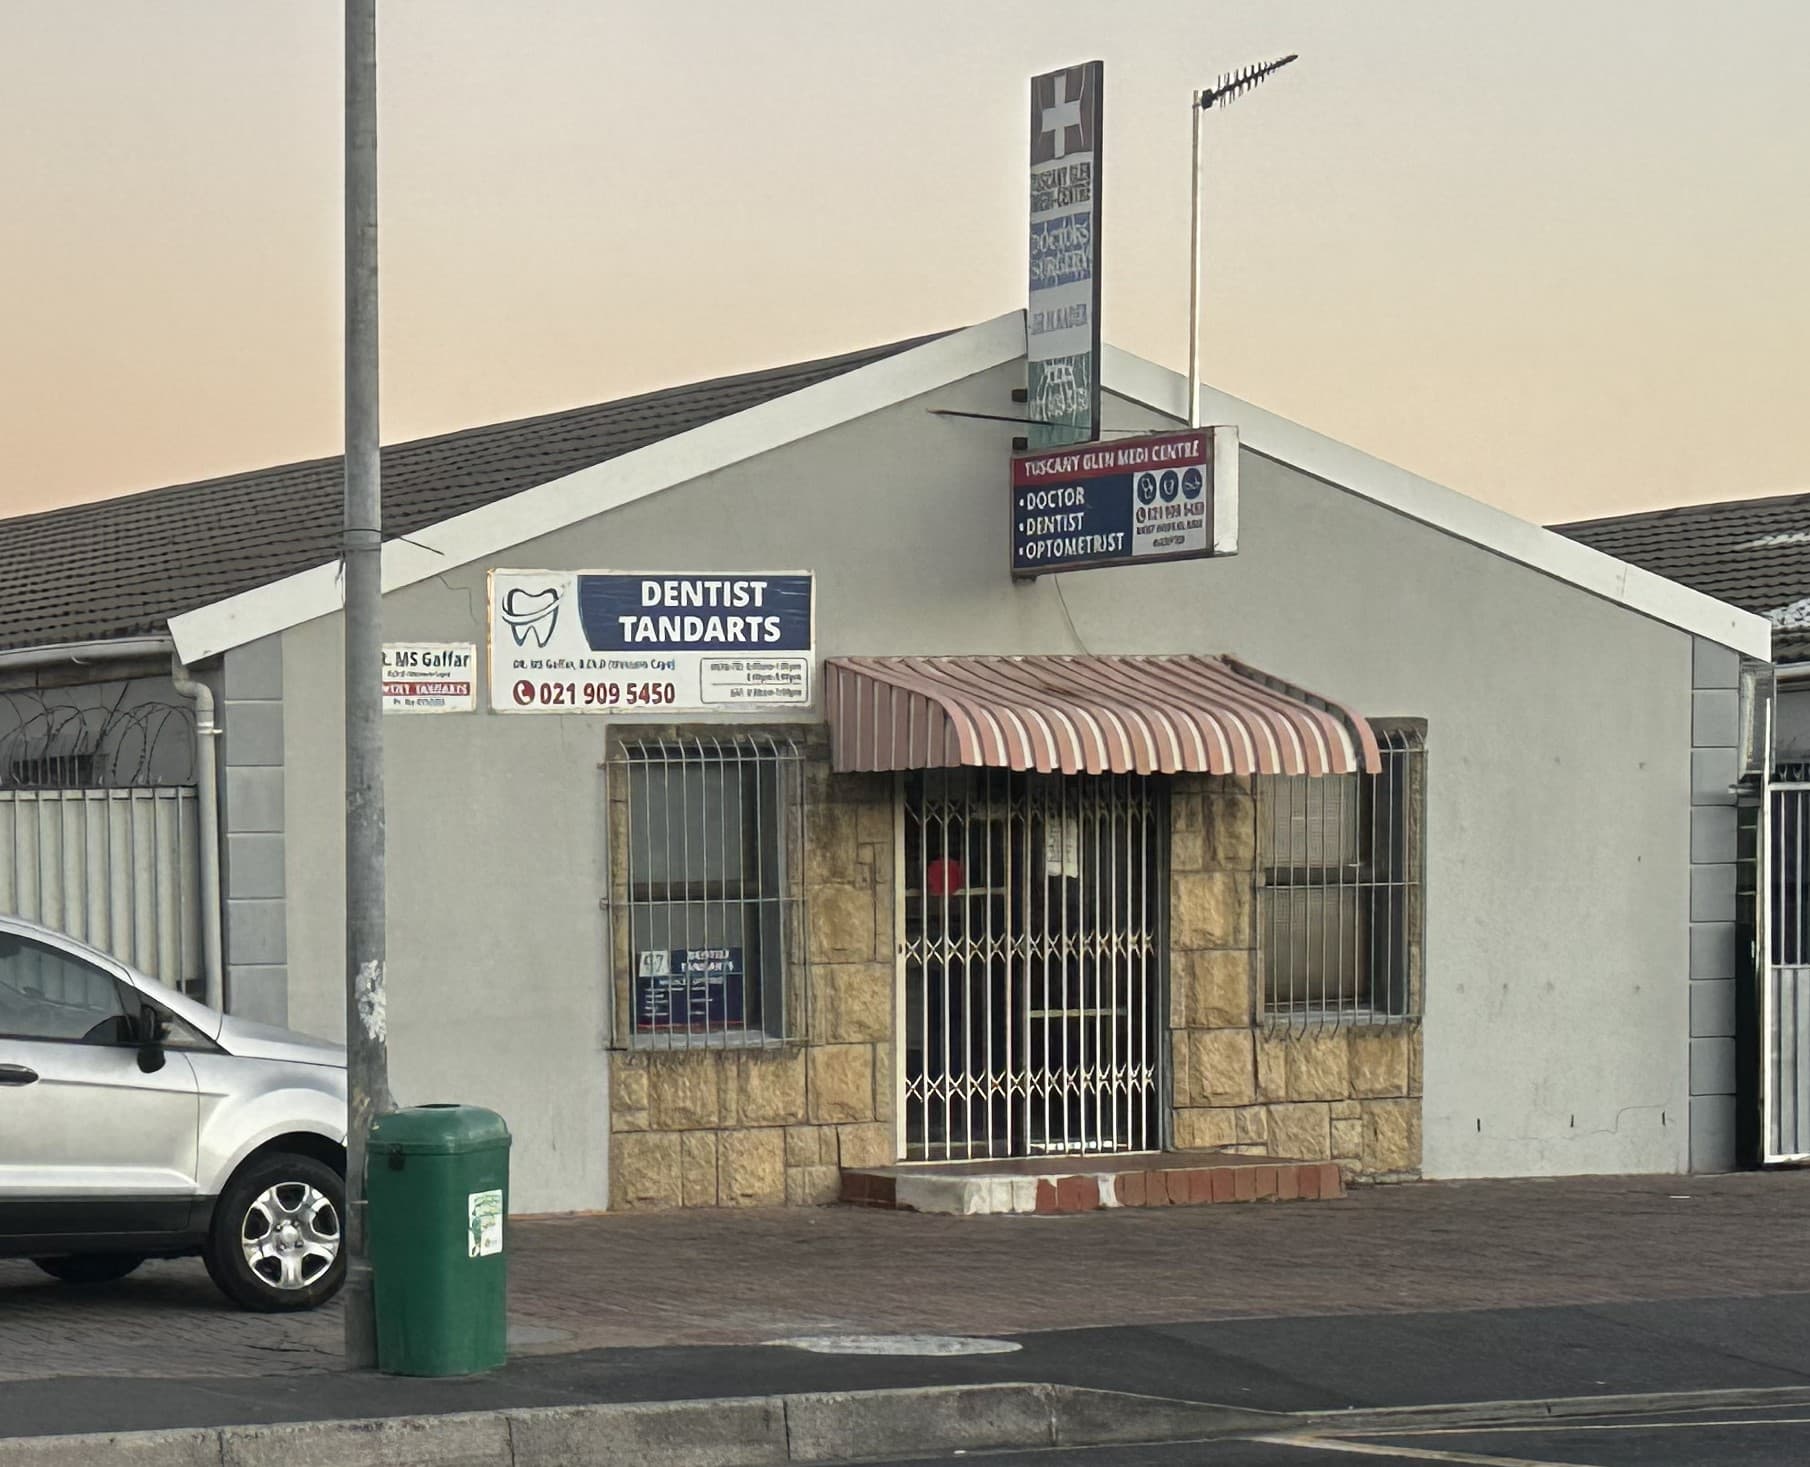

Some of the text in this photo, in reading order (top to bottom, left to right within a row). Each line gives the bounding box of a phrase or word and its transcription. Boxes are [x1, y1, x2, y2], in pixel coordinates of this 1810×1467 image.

[1025, 440, 1200, 477] TUSCANY GLEN MEDI CENTRE
[1026, 486, 1085, 510] DOCTOR
[1026, 512, 1084, 536] DENTIST
[1026, 532, 1125, 560] OPTOMETRIST
[641, 581, 767, 607] DENTIST
[618, 616, 781, 642] TANDARTS
[422, 650, 470, 668] Gaffar
[540, 682, 676, 705] 021 909 5450
